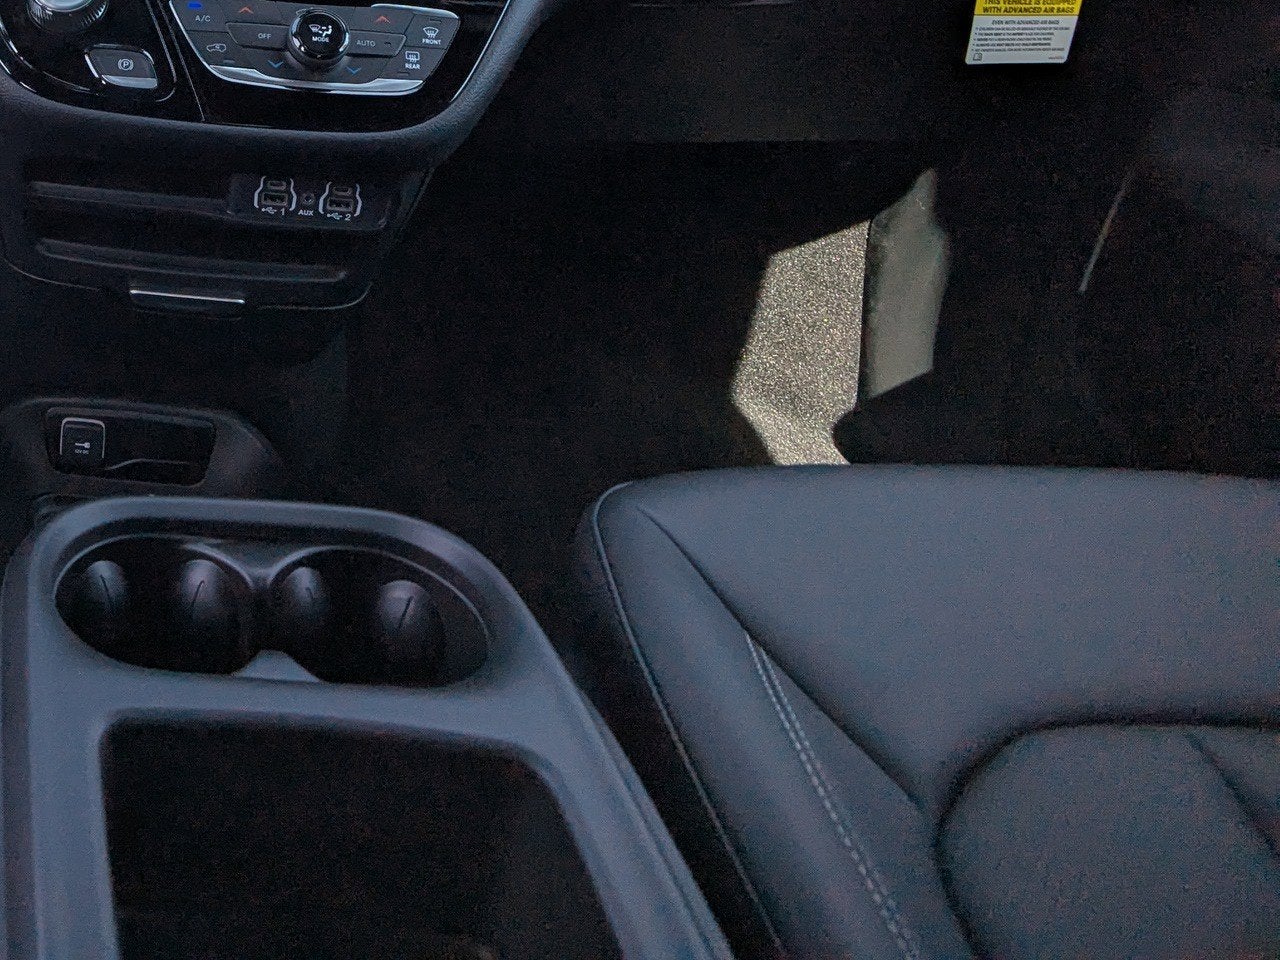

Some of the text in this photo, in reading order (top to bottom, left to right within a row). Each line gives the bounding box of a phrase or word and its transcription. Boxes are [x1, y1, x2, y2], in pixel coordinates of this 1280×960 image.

[195, 14, 211, 22] A/C
[356, 39, 376, 47] AUTO
[422, 38, 442, 46] FRONT
